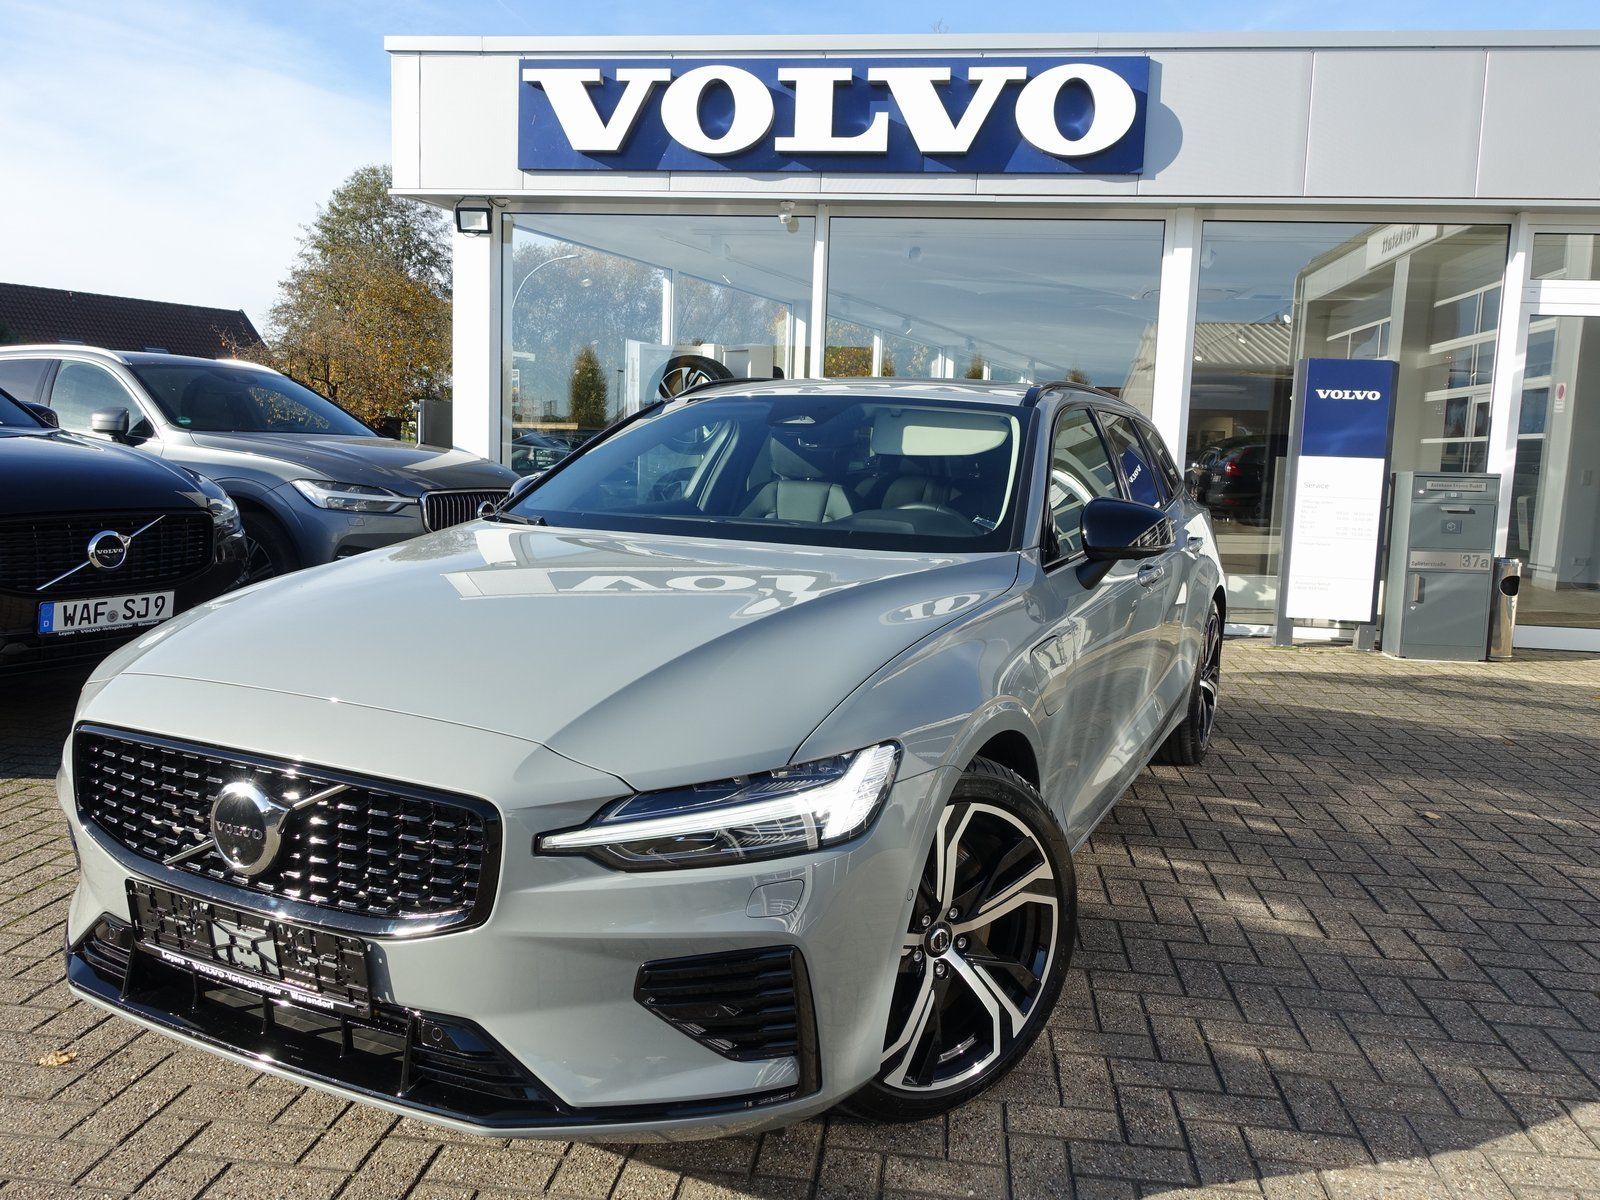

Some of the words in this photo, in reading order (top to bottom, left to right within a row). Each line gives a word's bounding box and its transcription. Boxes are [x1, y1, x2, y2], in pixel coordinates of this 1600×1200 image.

[522, 63, 1136, 157] VOLVO
[1315, 389, 1381, 401] VOLVO
[1303, 481, 1330, 490] Service
[1462, 554, 1489, 568] 37a
[63, 601, 108, 627] WAF
[215, 820, 263, 841] VOLVO
[161, 950, 186, 966] Leyers
[290, 991, 335, 1010] Warendorf
